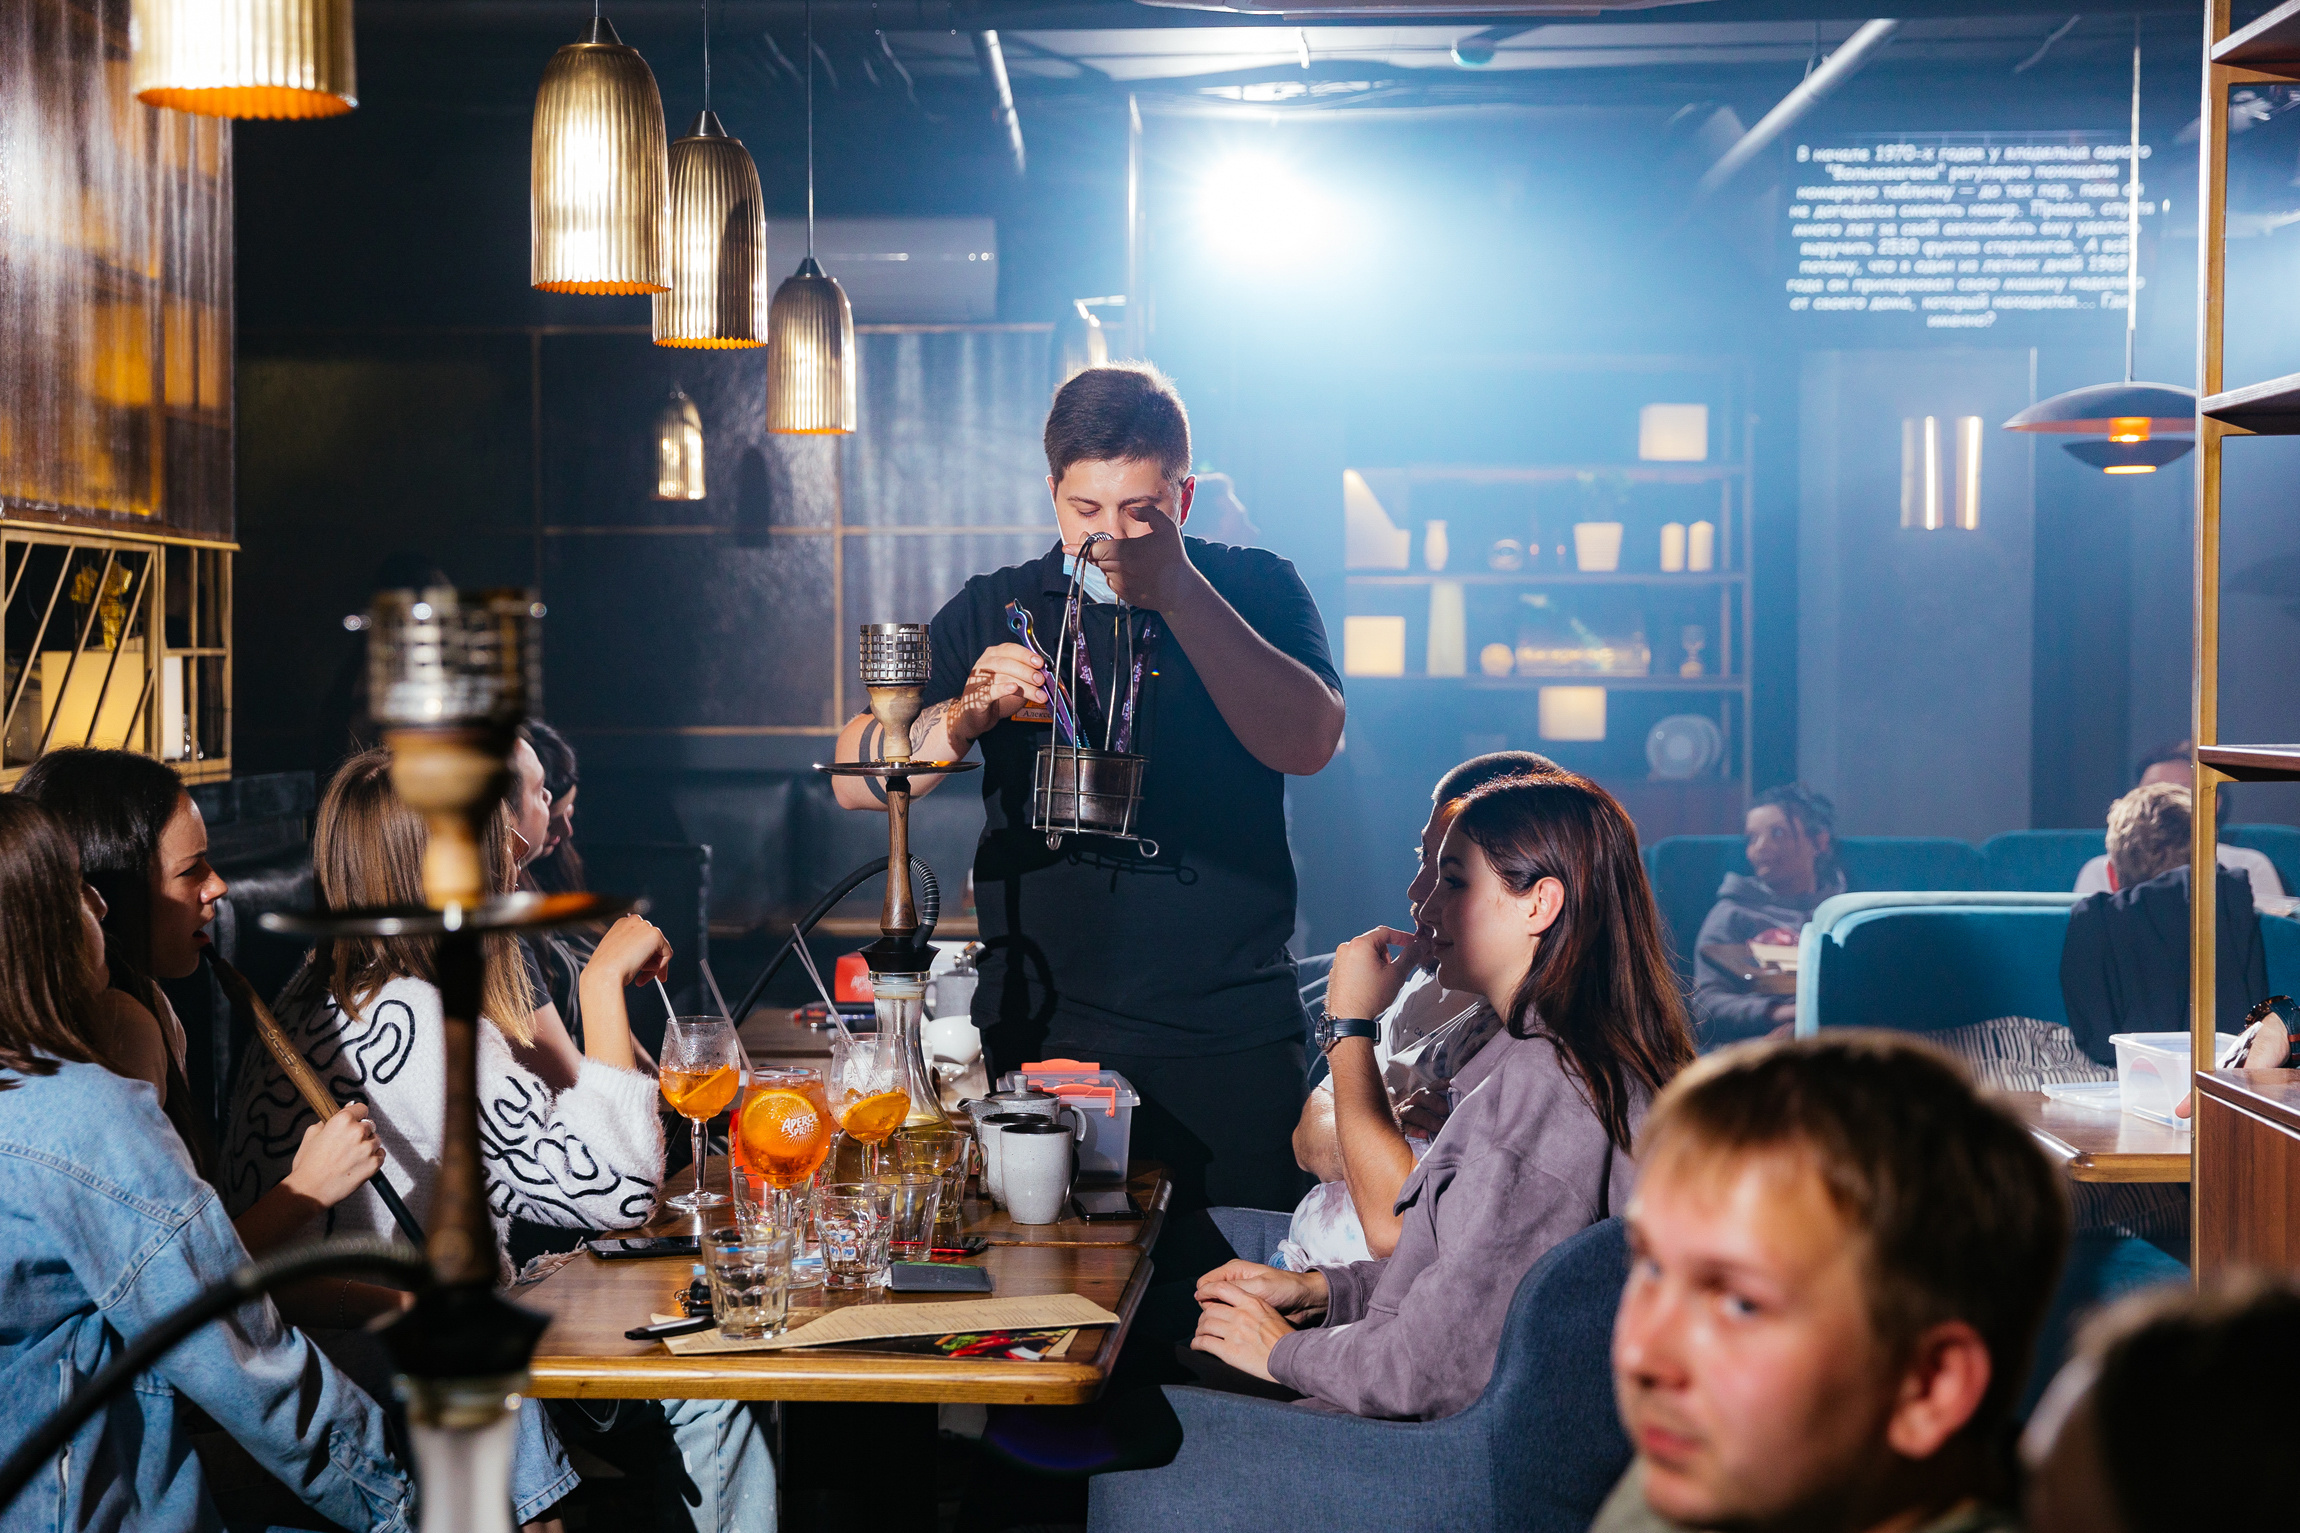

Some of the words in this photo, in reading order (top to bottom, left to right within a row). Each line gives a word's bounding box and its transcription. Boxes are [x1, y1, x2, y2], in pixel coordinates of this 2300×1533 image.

[1796, 145, 1810, 162] В
[1875, 144, 1935, 162] 1970-х
[1938, 147, 1985, 163] годов
[1988, 148, 2001, 164] у
[2093, 145, 2152, 160] одноо
[1948, 166, 2032, 183] регулярно
[1796, 186, 1879, 203] номерную
[1883, 182, 1955, 202] табличку
[2100, 202, 2155, 218] спутя
[2070, 277, 2145, 291] недалео
[781, 1111, 819, 1132] APEROL
[788, 1123, 814, 1138] SPRITZ
